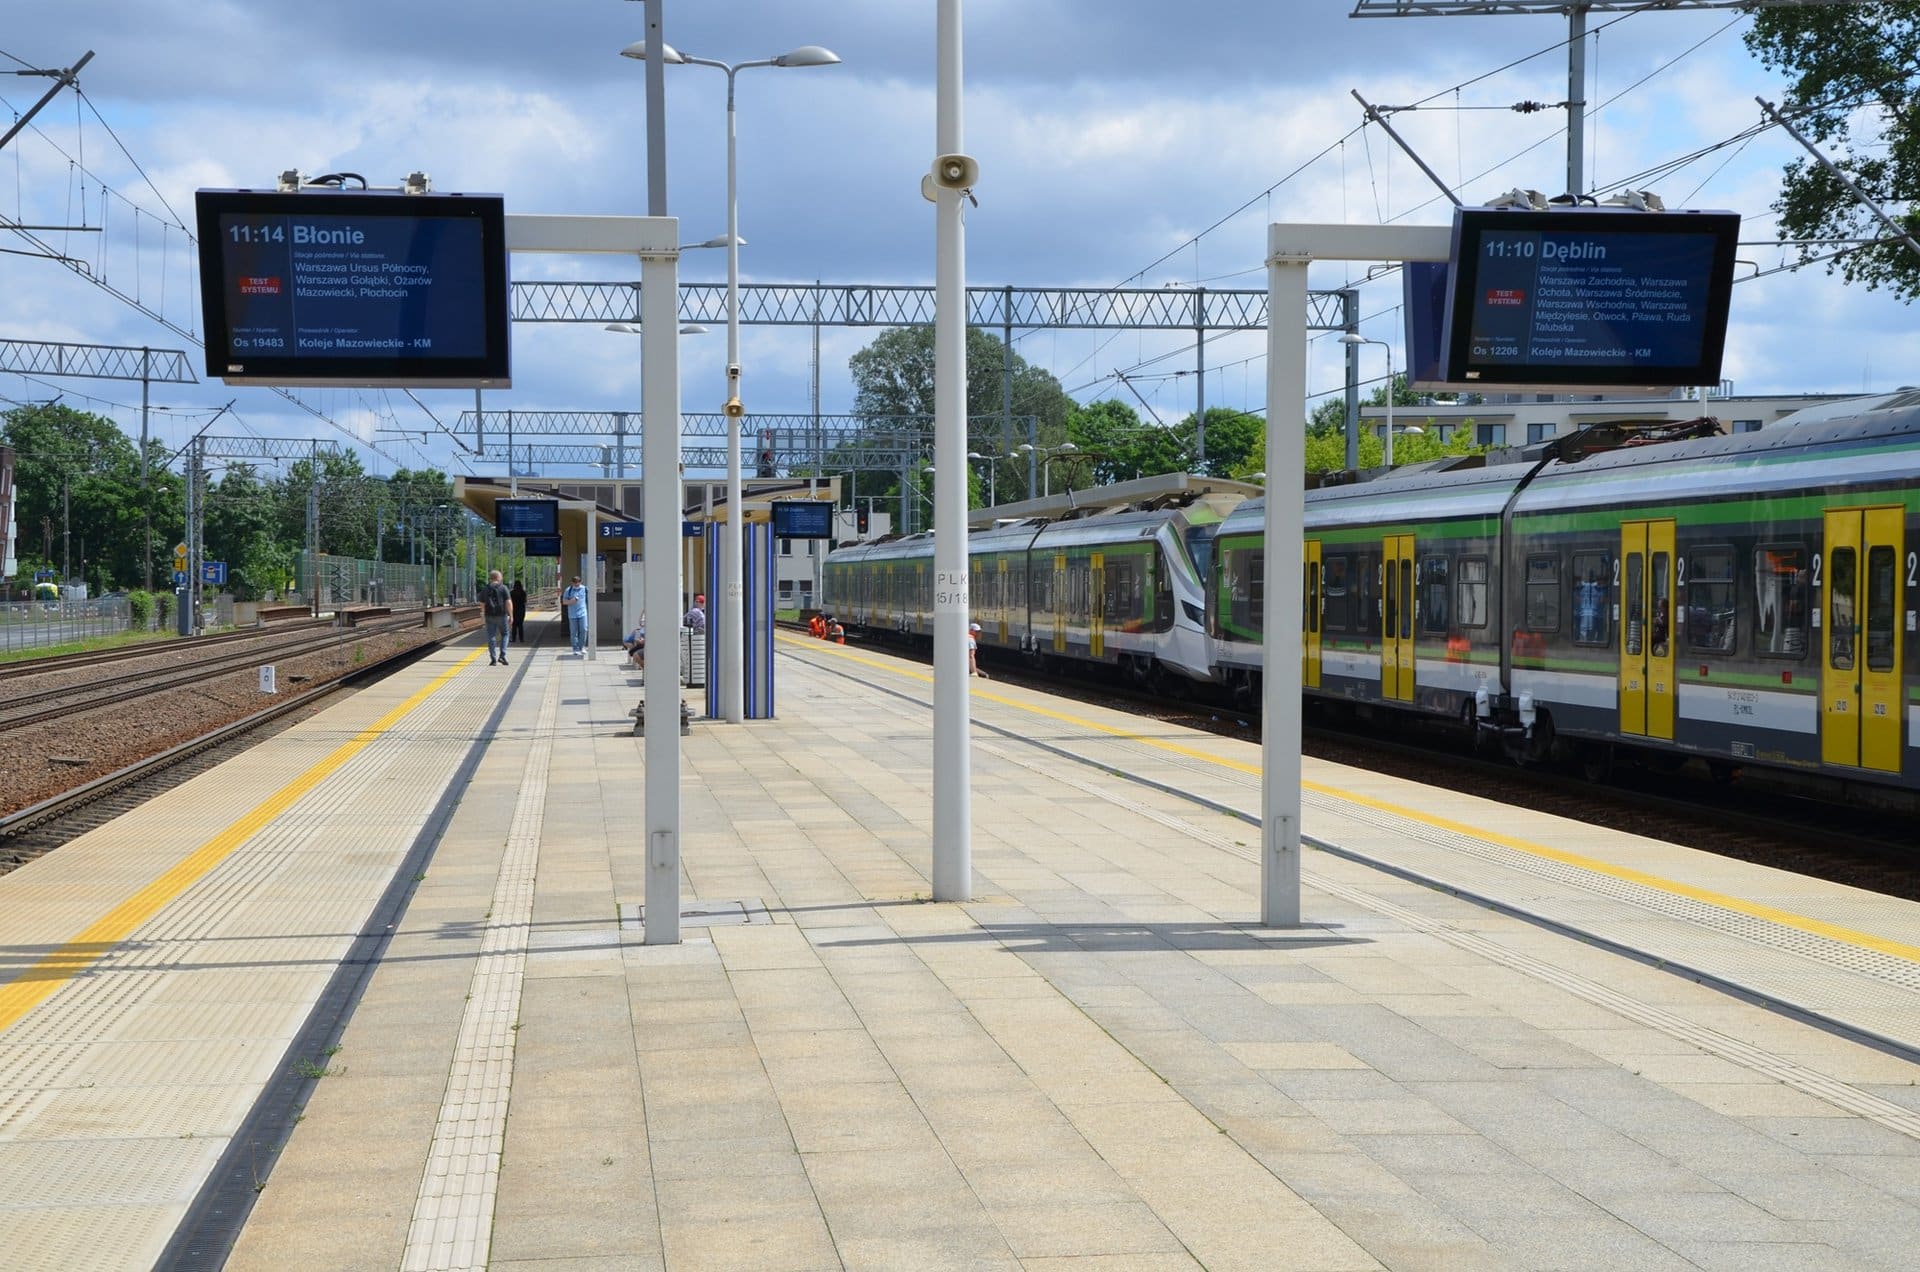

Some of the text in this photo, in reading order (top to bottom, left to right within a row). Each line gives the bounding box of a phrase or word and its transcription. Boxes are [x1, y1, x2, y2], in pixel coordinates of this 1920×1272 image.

[229, 225, 365, 245] 11:14 Błonie
[1486, 241, 1607, 262] 11:10 Dęblin
[295, 263, 430, 275] Warszawa Ursus Północny,
[296, 275, 348, 285] Warszawa
[350, 275, 391, 287] Gołąbki,
[1539, 275, 1688, 287] Warszawa Zachodnia, Warszawa
[241, 286, 279, 294] SYSTEMU
[296, 287, 358, 298] Mazowiecki,
[1538, 287, 1573, 298] Ochota,
[1576, 288, 1623, 297] Warszawa
[1537, 299, 1688, 311] Warszawa Wschodnia, Warszawa
[1593, 312, 1630, 323] Otwock,
[1667, 312, 1691, 322] Ruda
[233, 338, 249, 348] Os
[299, 338, 333, 350] Koleje
[336, 338, 404, 348] Mazowieckie
[414, 338, 432, 348] KM
[1473, 346, 1519, 356] Os 12206
[1531, 346, 1562, 358] Koleje
[1564, 347, 1626, 357] Mazowieckie
[1634, 348, 1652, 357] KM
[603, 526, 611, 536] 3
[1612, 558, 1620, 587] 2
[1677, 556, 1685, 587] 2
[1812, 553, 1822, 587] 2
[1906, 551, 1918, 588] 2
